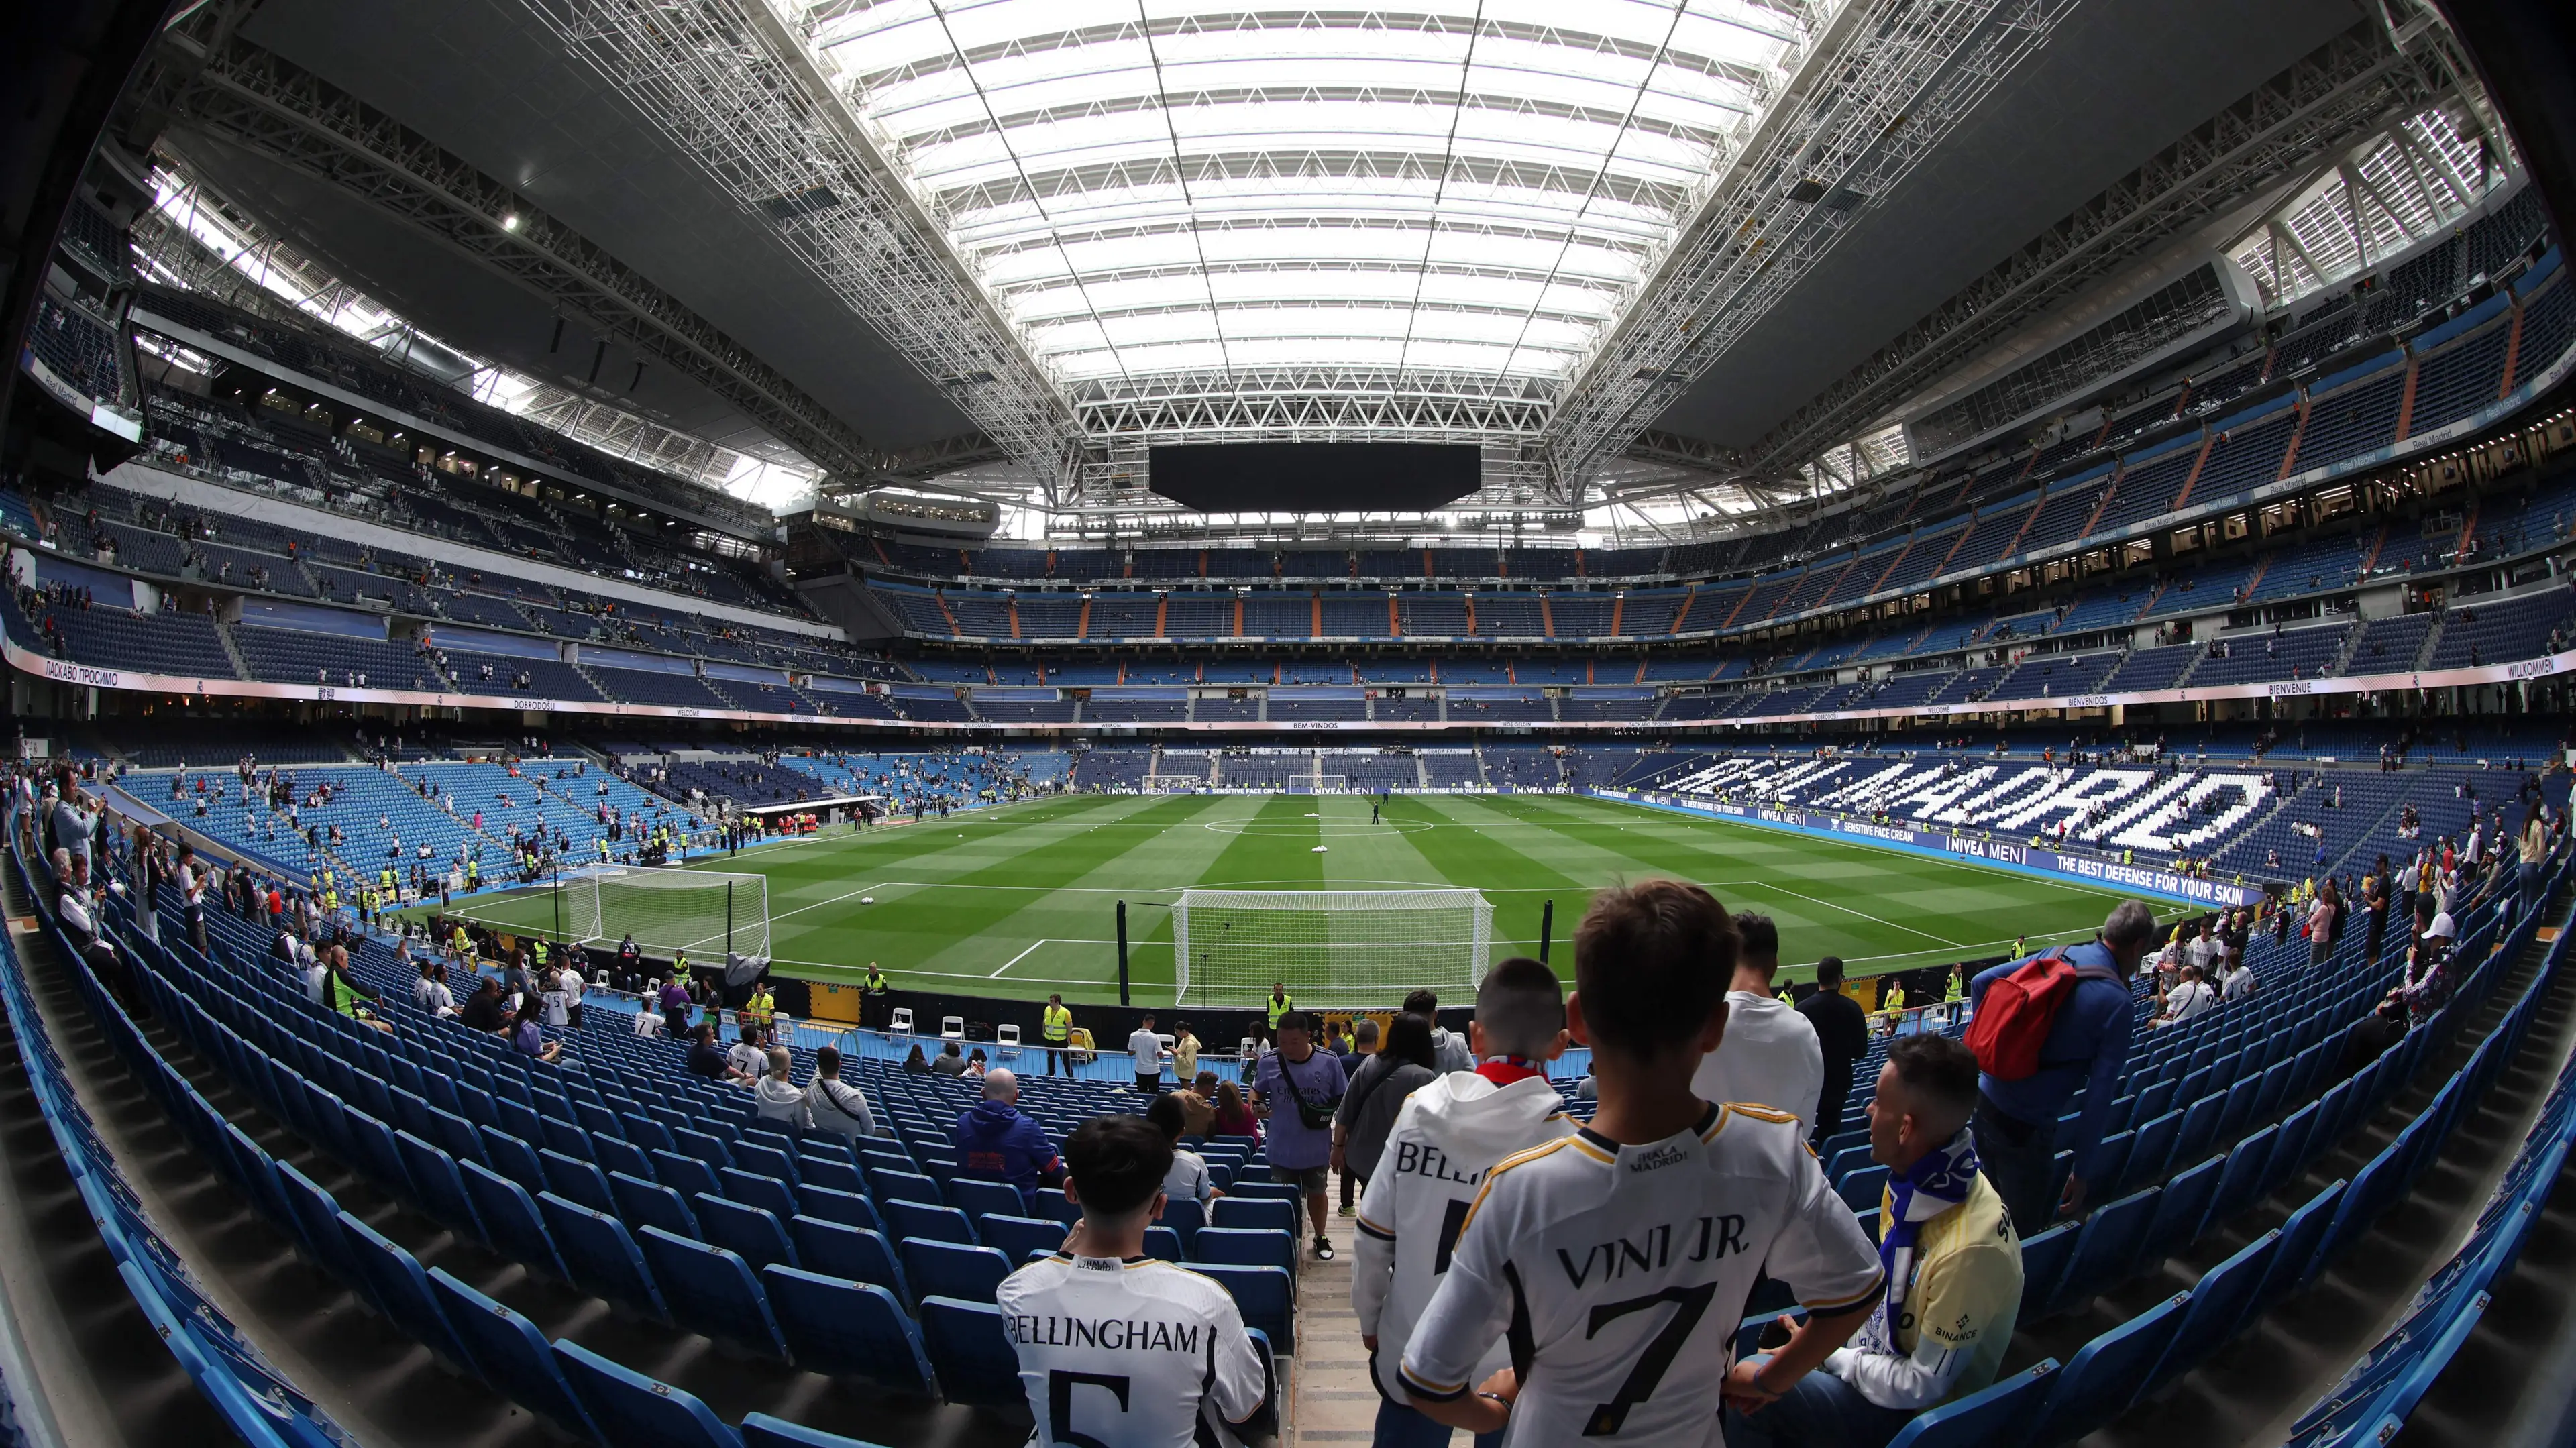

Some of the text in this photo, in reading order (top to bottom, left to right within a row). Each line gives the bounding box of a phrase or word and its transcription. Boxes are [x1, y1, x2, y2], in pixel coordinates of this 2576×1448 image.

[46, 375, 78, 406] Real Madrid
[2486, 393, 2521, 421] Real Madrid
[2412, 430, 2452, 449] Real Madrid
[2339, 453, 2376, 472] Real Madrid
[2271, 477, 2306, 494] Real Madrid
[2206, 496, 2238, 511] Real Madrid
[2145, 515, 2176, 530] Real Madrid
[2090, 531, 2117, 544] Real Madrid
[2049, 547, 2065, 555] Madrid
[1992, 558, 2015, 569] Real Madrid
[1958, 571, 1971, 579] Madrid
[46, 661, 118, 686] ЛАСКАВО ПРОСИМО
[2508, 658, 2555, 679] WILLKOMMEN
[2269, 682, 2312, 695] BIENVENUE
[514, 700, 555, 710] DOBRODOŠLI
[2069, 696, 2108, 707] BIENVENIDOS
[677, 709, 700, 717] WELCOME
[1928, 706, 1949, 714] WELCOME
[1599, 789, 1612, 797] SENSITIVE
[1644, 795, 1668, 805] NIVEA MEN
[1688, 800, 1697, 808] BEST
[1697, 801, 1713, 811] DEFENSE
[1721, 804, 1733, 814] YOUR
[1733, 806, 1744, 816] SKIN
[1761, 810, 1802, 825] NIVEA MEN
[1844, 822, 1913, 842] SENSITIVE FACE CREAM
[1951, 836, 2020, 863] NIVEA MEN
[2057, 856, 2243, 906] THE BEST DEFENSE FOR YOUR SKIN
[553, 996, 560, 1007] 5
[638, 1020, 646, 1035] 7
[736, 1058, 749, 1074] 7
[1631, 1151, 1688, 1174] MADRID!
[1556, 1214, 1750, 1290] VINI JR.
[1008, 1315, 1198, 1354] BELLINGHAM
[1935, 1326, 1978, 1342] BINANCE
[1582, 1282, 1719, 1437] 7
